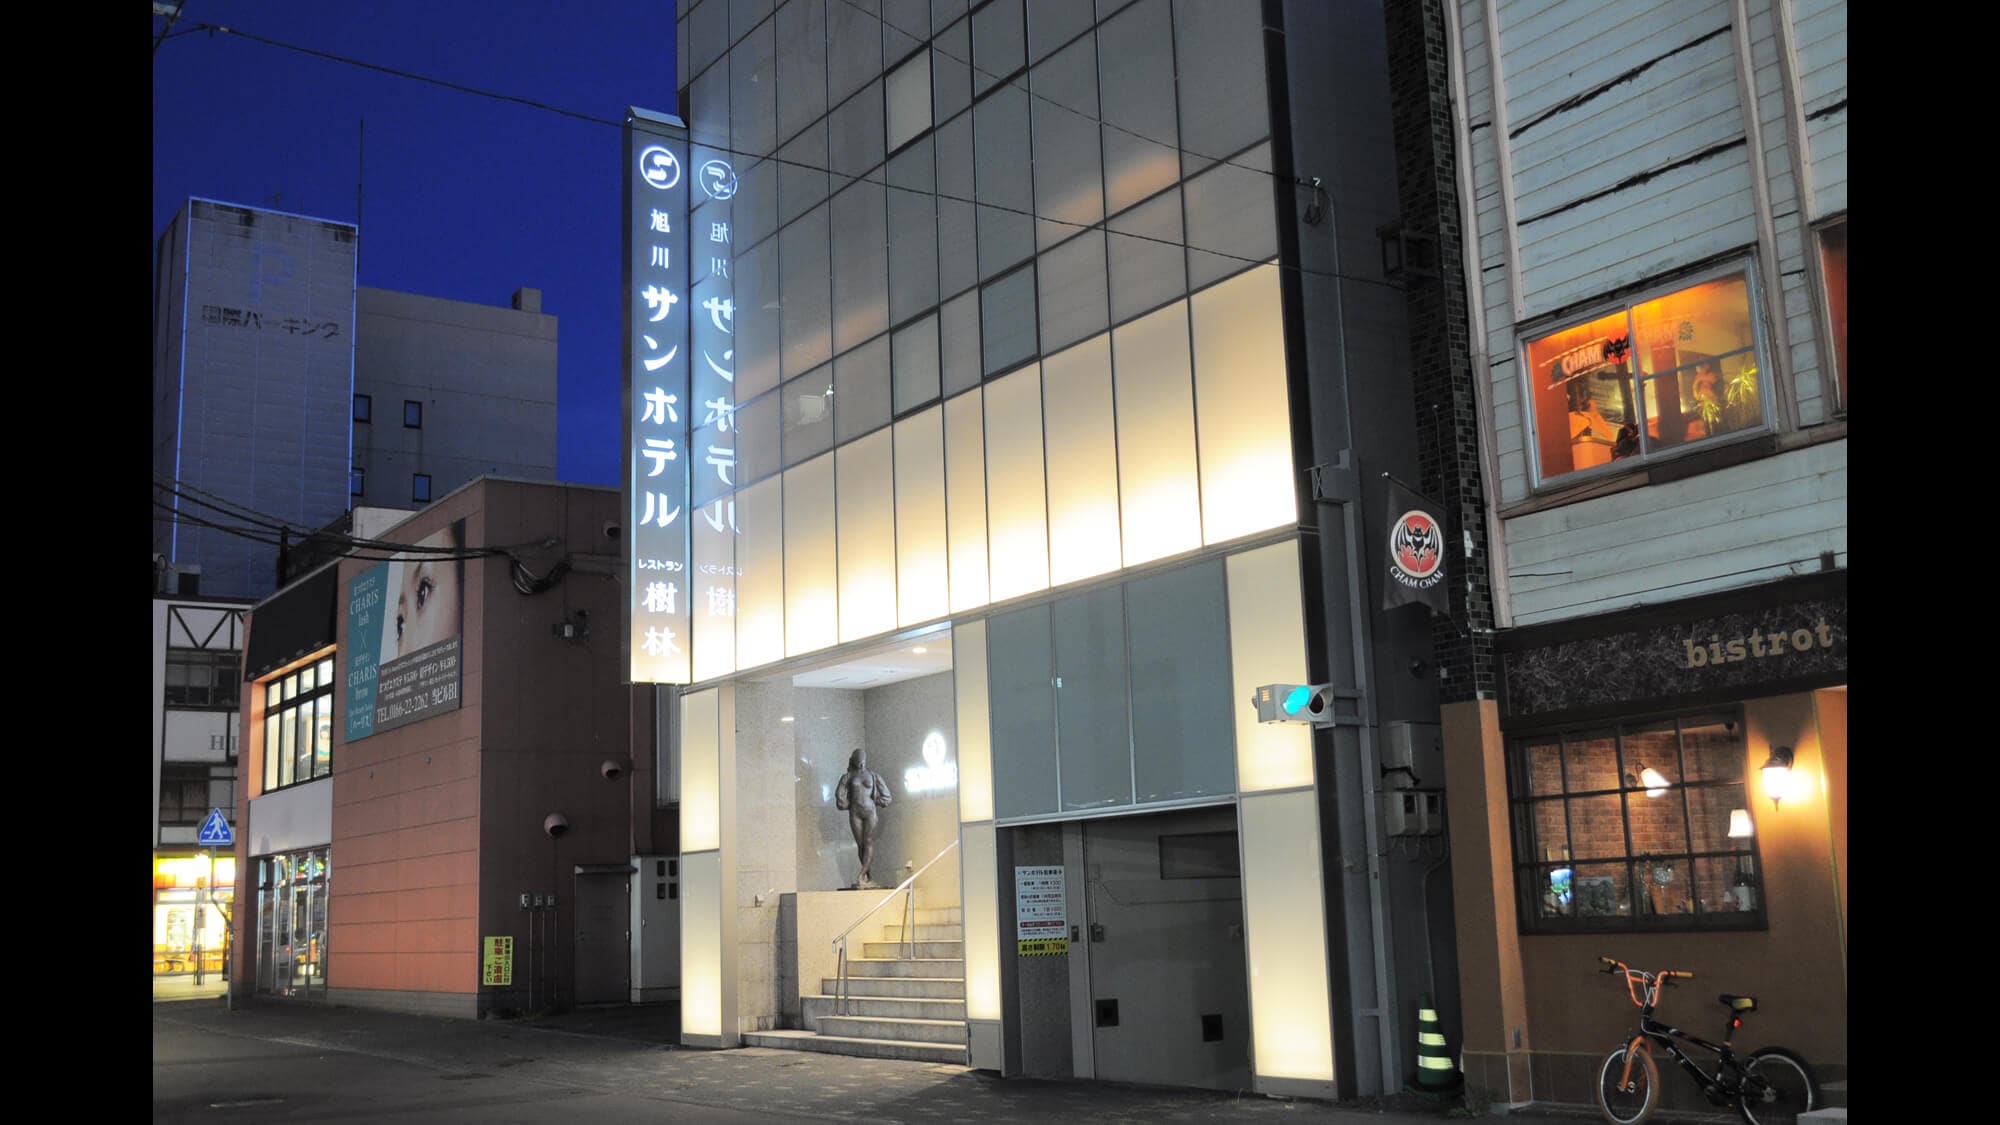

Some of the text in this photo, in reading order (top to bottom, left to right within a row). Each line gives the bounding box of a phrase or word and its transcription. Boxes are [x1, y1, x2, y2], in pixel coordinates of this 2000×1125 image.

[1562, 347, 1600, 376] CHAM
[638, 558, 683, 572] レストラン
[1389, 565, 1444, 590] CHAM CHAM
[350, 589, 379, 615] CHARIS
[641, 581, 680, 657] 樹林
[1682, 616, 1835, 669] bistrot
[348, 663, 378, 687] CHARIS
